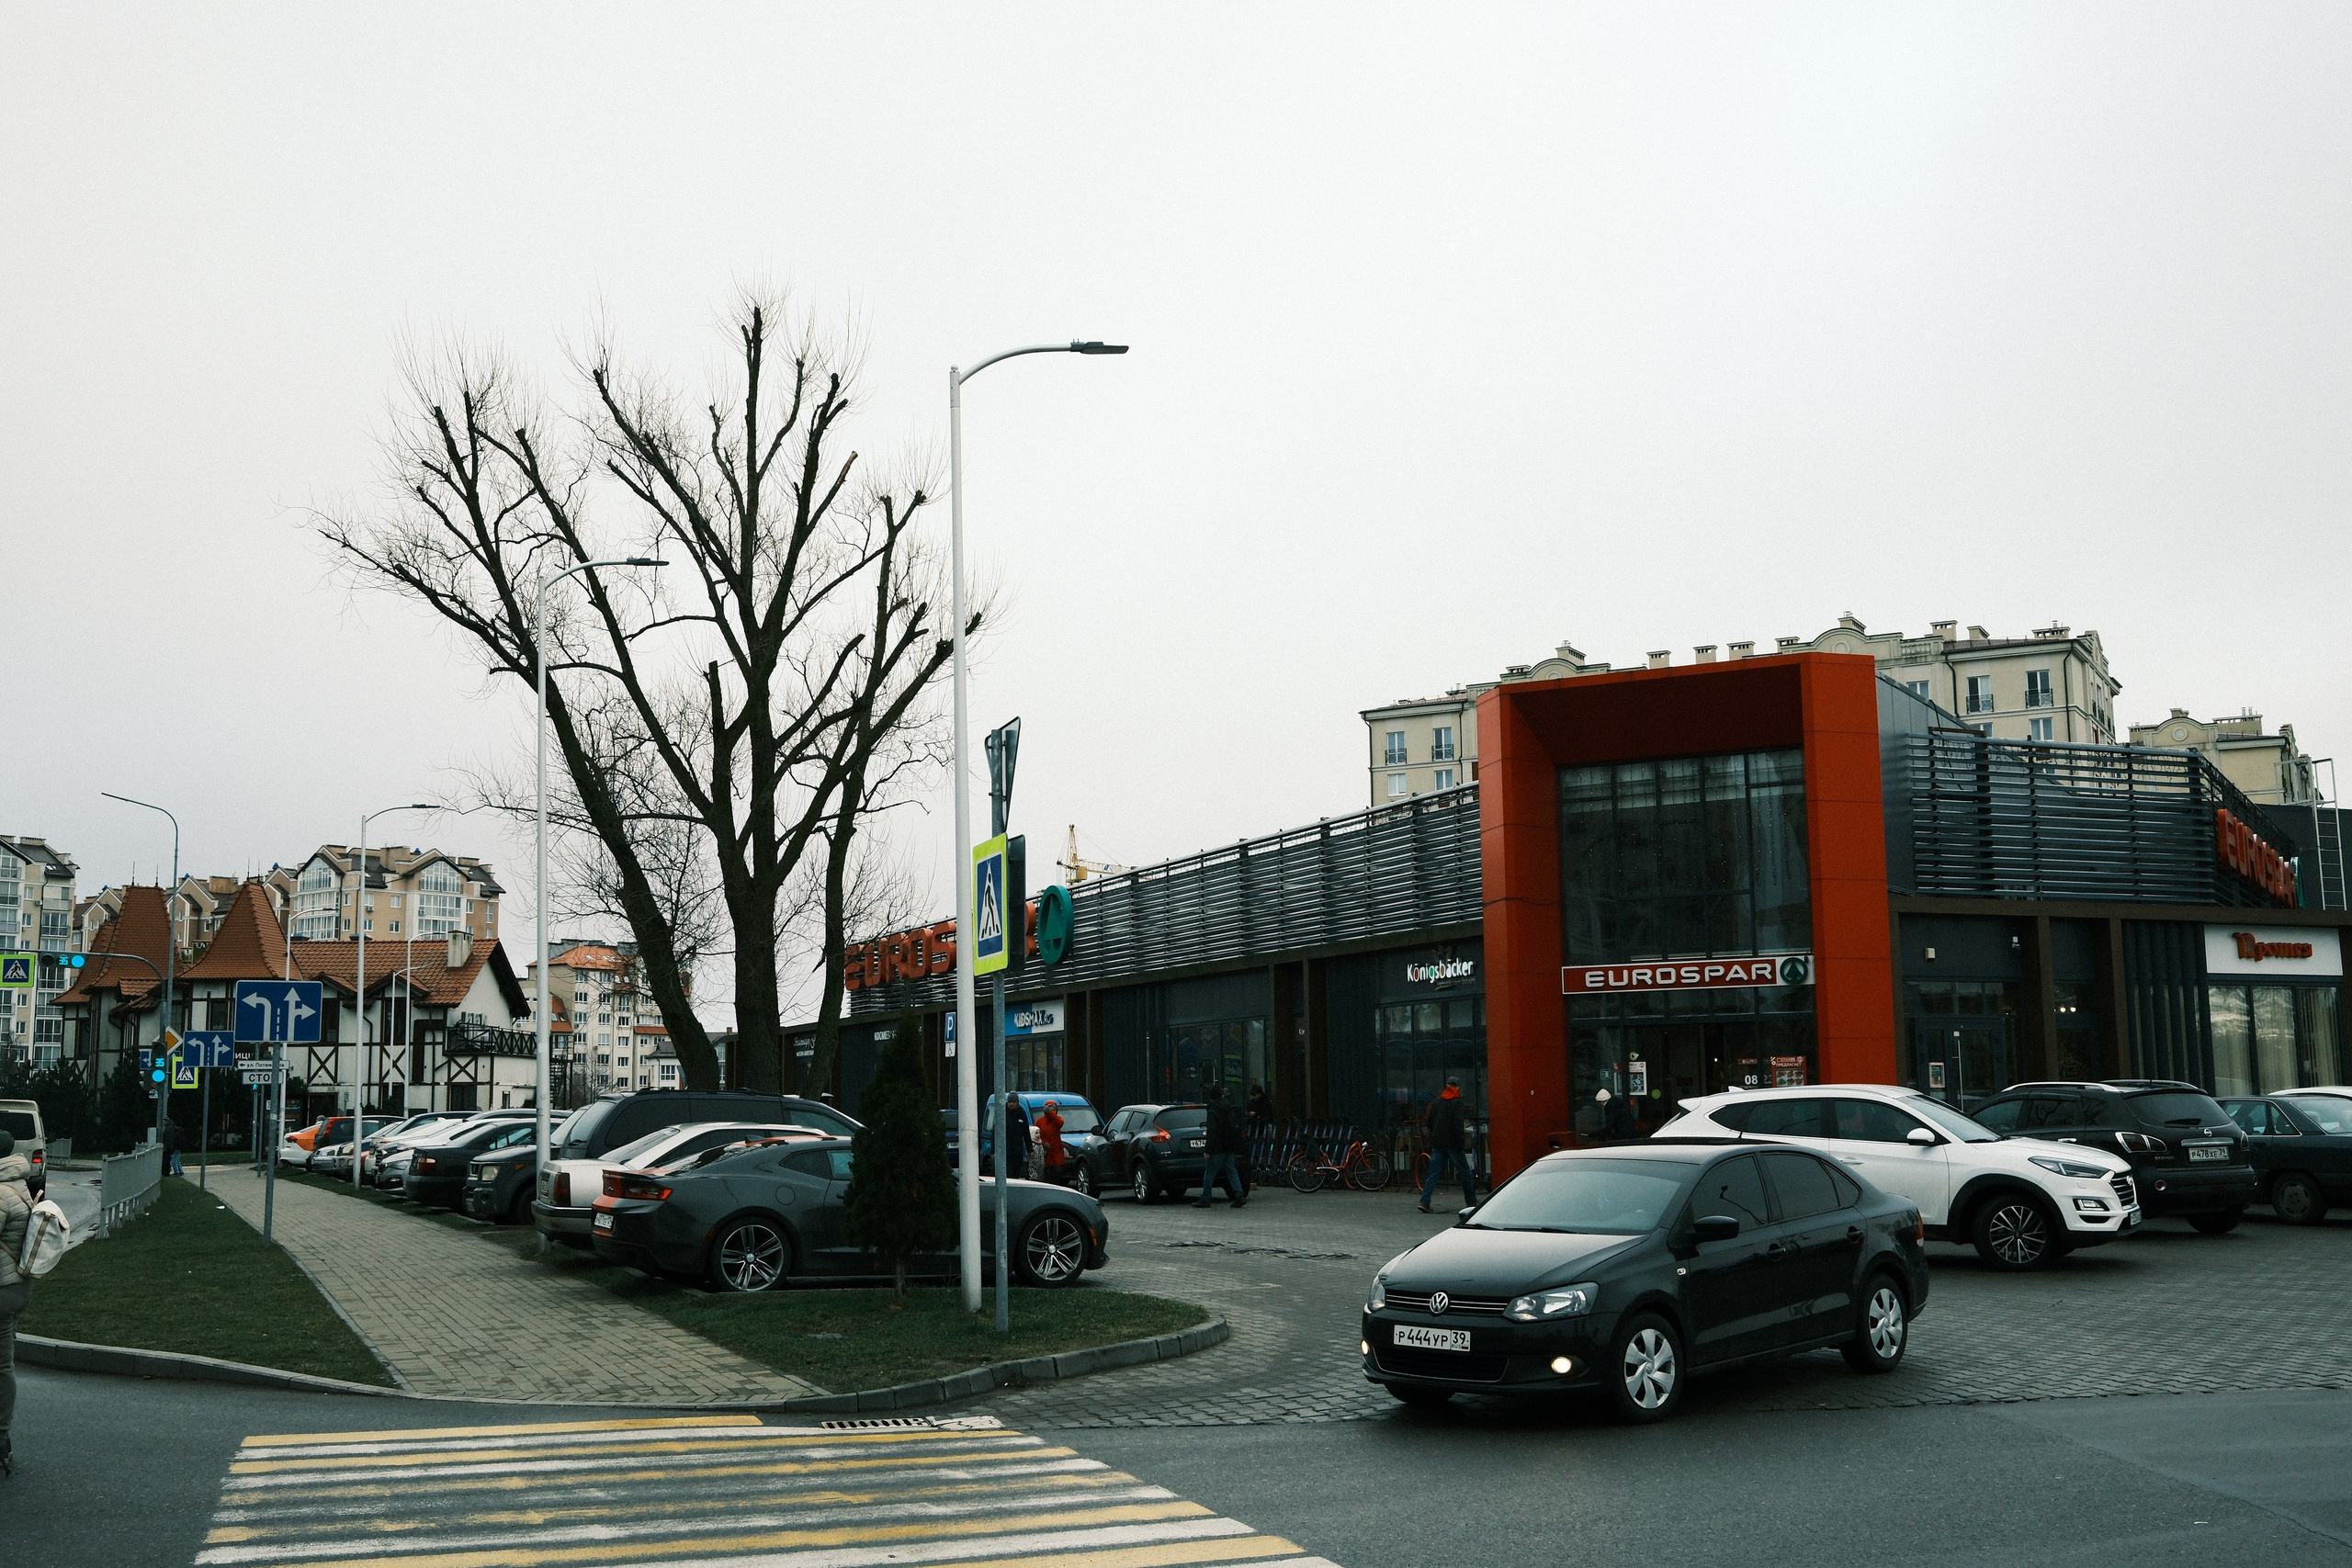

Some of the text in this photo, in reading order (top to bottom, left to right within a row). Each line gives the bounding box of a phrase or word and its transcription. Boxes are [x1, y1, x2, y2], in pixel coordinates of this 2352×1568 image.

[59, 956, 69, 965] 35
[1585, 964, 1772, 987] EUROSPAR
[155, 1057, 164, 1067] 35
[1744, 1075, 1758, 1085] 08
[1398, 1328, 1466, 1348] Р444УР 39
